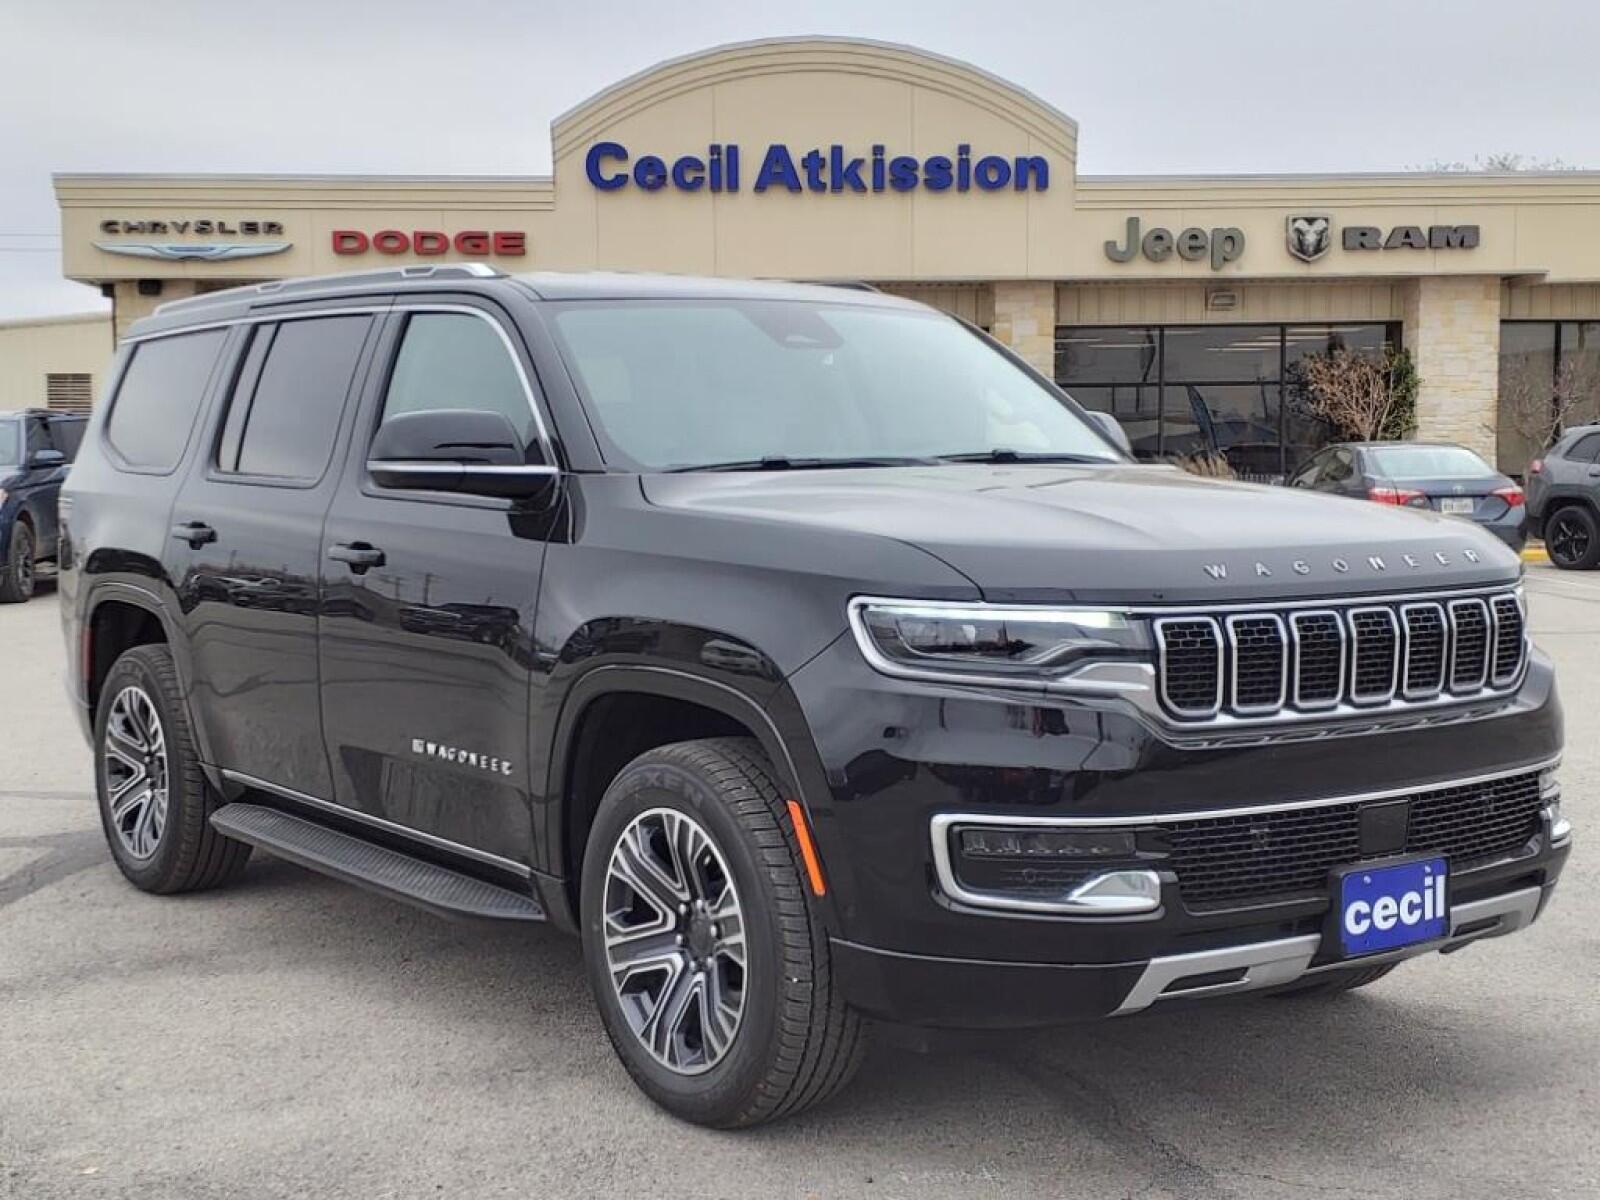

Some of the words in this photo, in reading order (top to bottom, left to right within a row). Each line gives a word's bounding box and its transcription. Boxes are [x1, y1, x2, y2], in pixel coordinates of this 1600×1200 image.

[585, 142, 740, 193] Cecil
[753, 144, 1050, 193] Atkission
[100, 219, 285, 236] CHRYSLER
[332, 229, 526, 256] DODGE
[1341, 224, 1481, 251] RAM
[1104, 216, 1246, 271] Jeep
[1203, 549, 1481, 580] WAGONEER
[1344, 874, 1446, 935] cecil
